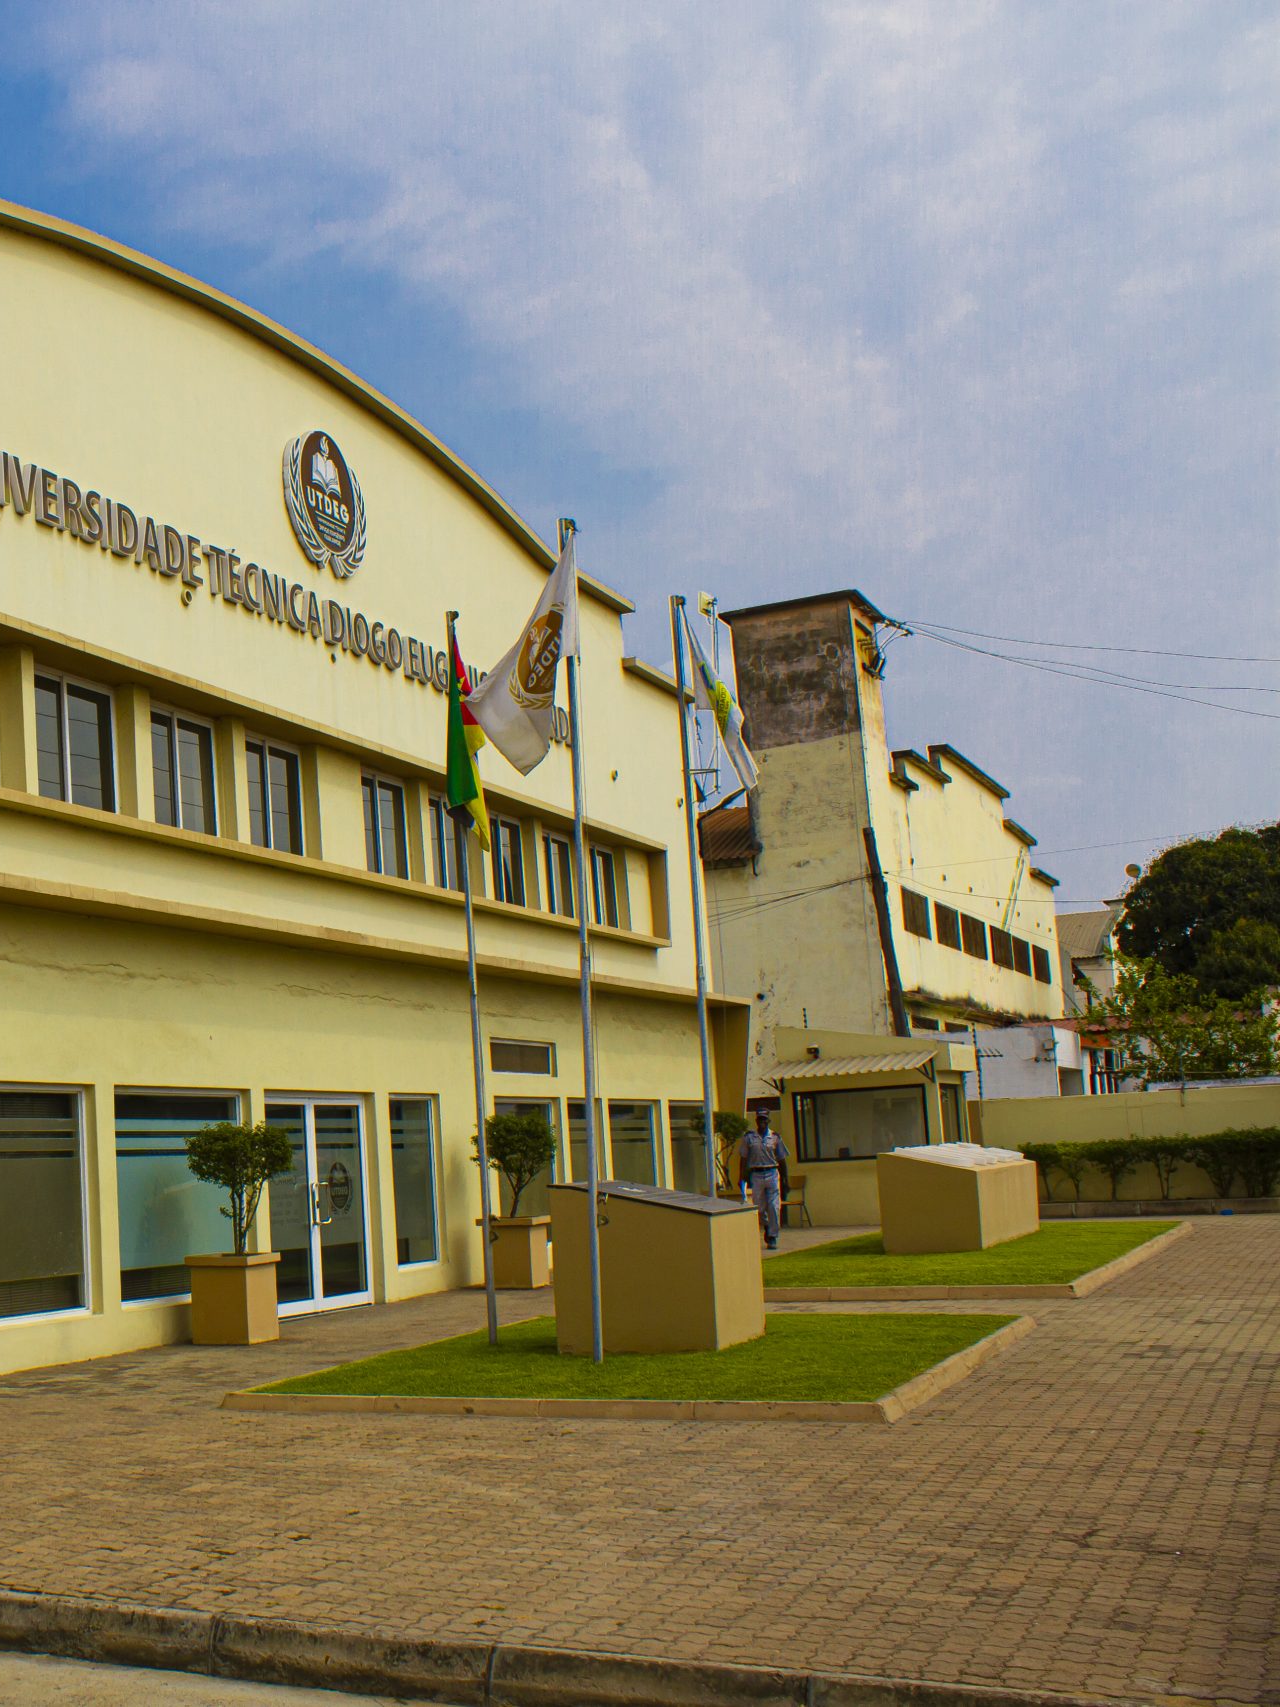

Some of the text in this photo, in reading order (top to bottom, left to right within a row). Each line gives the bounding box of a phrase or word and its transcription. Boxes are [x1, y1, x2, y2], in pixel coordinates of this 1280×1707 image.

[306, 486, 349, 523] UTDEG
[202, 545, 322, 638] TÉCNICA
[322, 600, 403, 670] DIOGO
